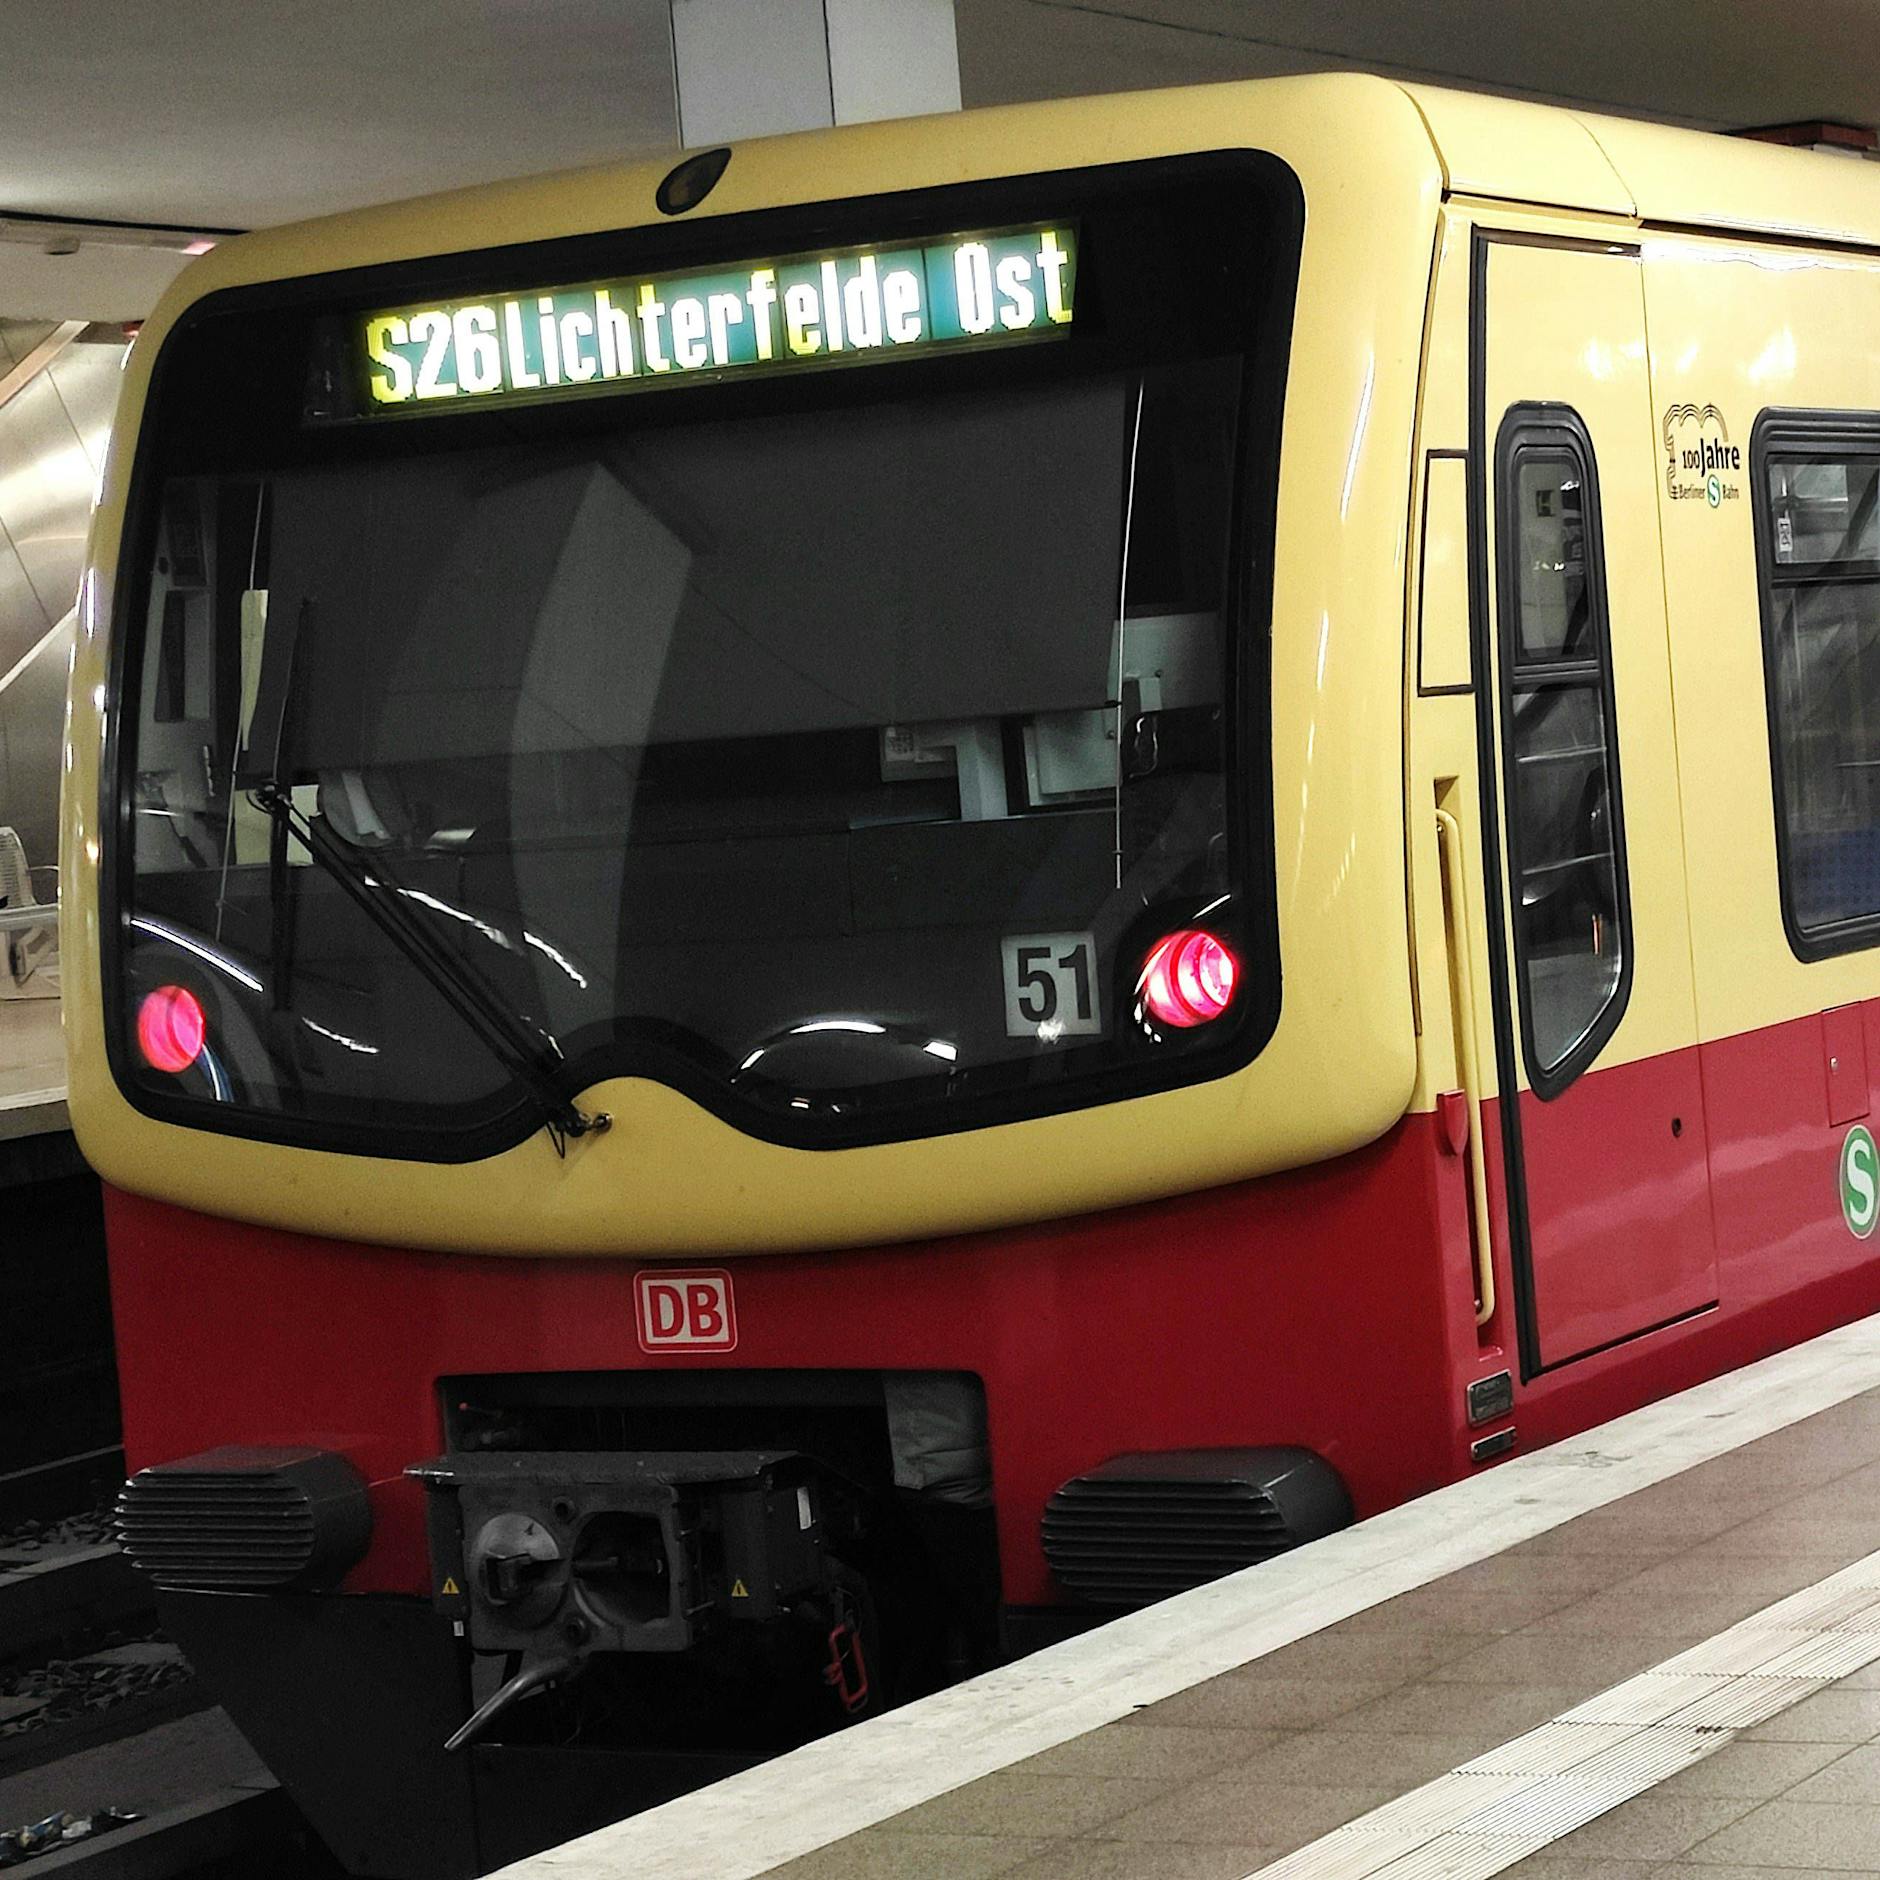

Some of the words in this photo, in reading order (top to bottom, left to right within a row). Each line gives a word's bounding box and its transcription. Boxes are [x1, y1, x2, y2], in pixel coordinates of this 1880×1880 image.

[366, 304, 502, 404] S26
[504, 254, 922, 390] Lichterfelde
[953, 230, 1073, 335] Ost
[1016, 944, 1092, 1022] 51
[1846, 1139, 1875, 1226] S
[648, 1284, 723, 1338] DB
